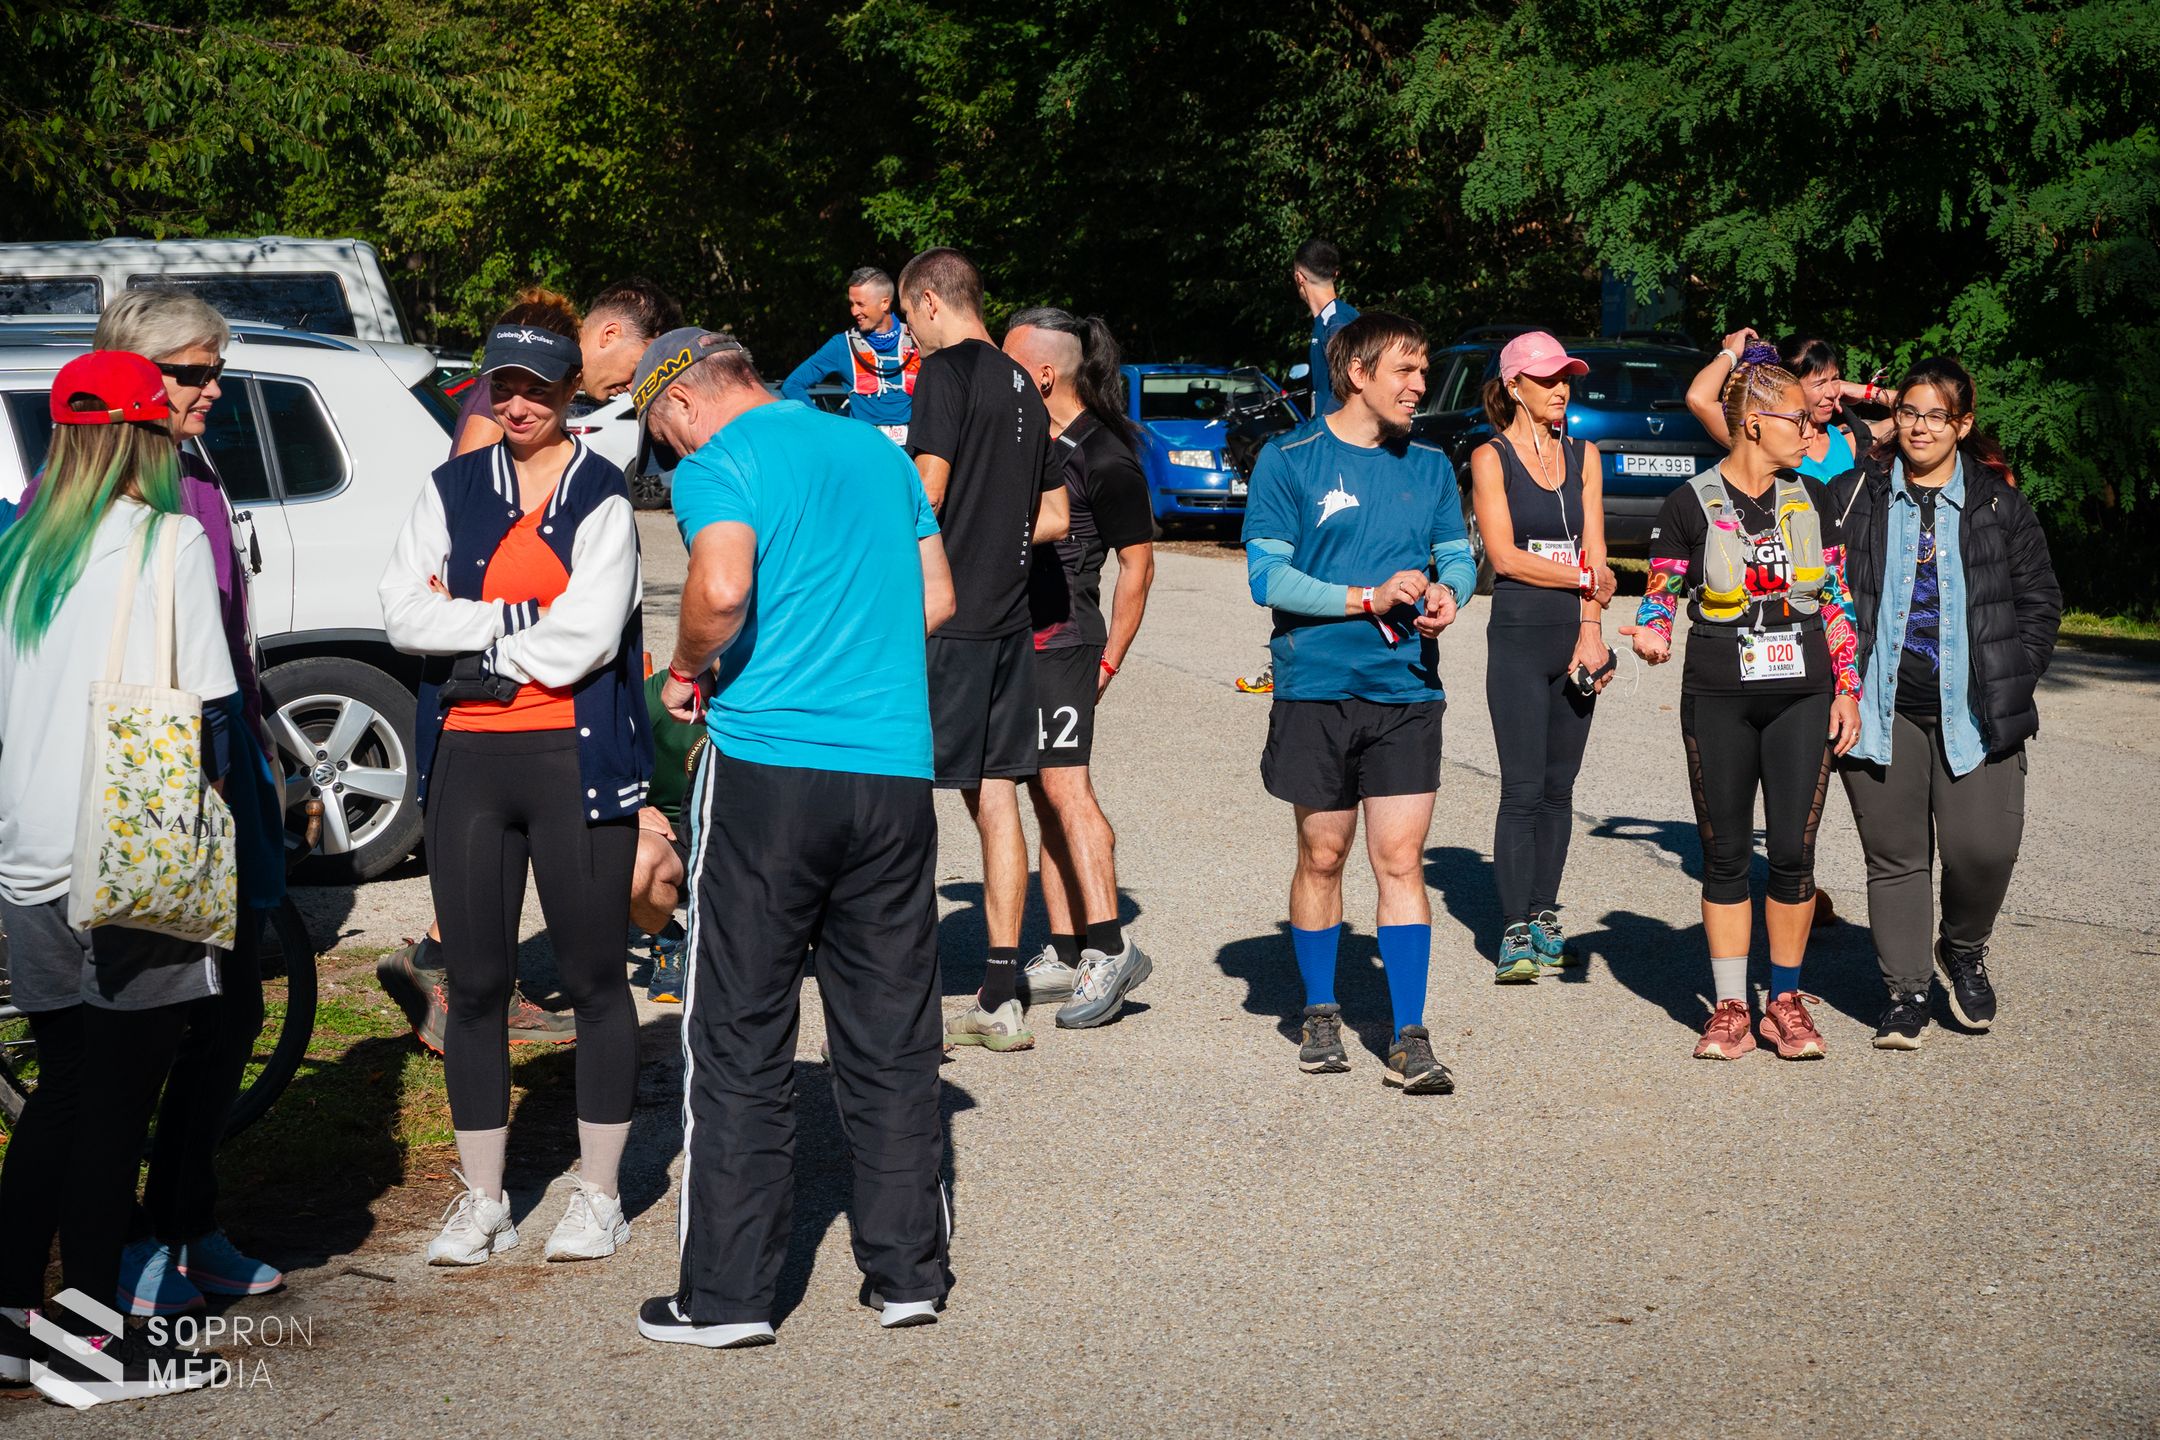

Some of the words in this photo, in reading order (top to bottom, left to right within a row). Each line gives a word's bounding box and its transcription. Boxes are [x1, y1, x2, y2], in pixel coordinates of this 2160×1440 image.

[632, 348, 693, 410] TEAM
[1627, 457, 1692, 473] PPK-996
[1767, 644, 1793, 662] 020
